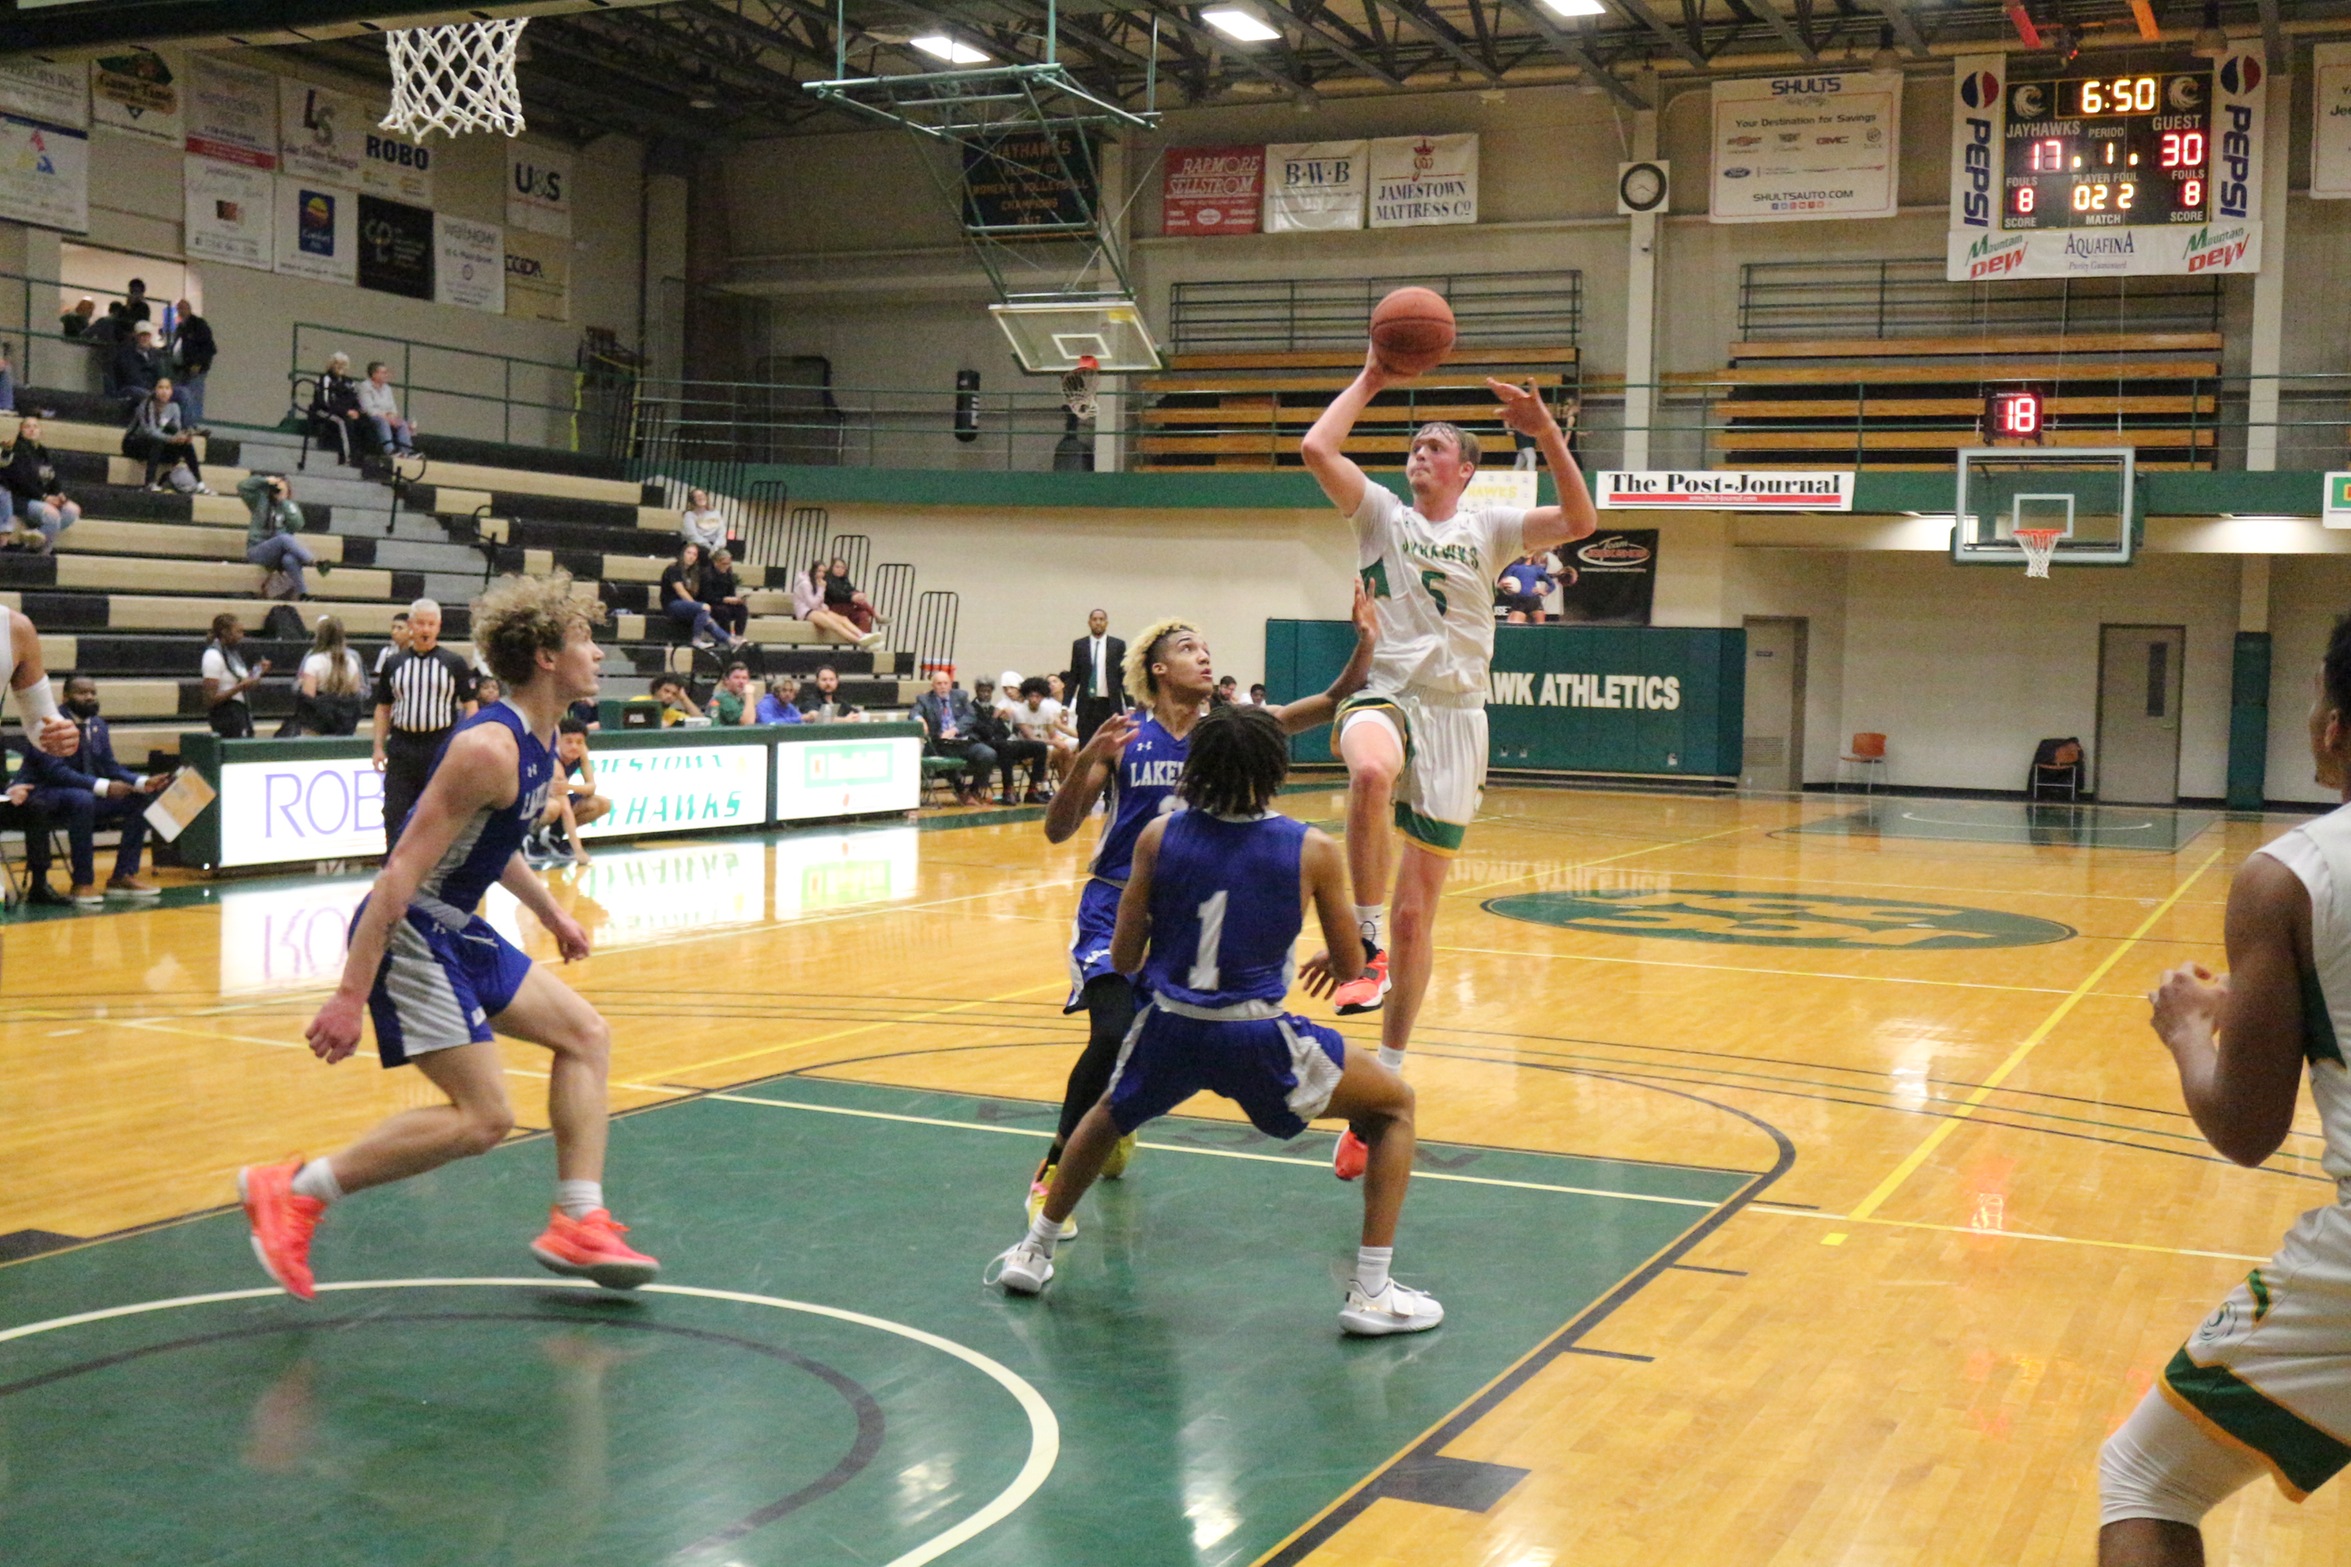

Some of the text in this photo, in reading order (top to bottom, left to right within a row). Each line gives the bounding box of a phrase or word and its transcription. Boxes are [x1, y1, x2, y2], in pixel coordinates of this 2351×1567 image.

[1771, 77, 1841, 95] SHULTS
[2082, 78, 2156, 114] 6:50
[1736, 113, 1876, 129] Your Destination for Savings
[2006, 114, 2202, 138] JAYHAWKS PERIOD GUEST
[366, 133, 429, 171] ROBO
[2031, 140, 2062, 170] 17
[2161, 133, 2204, 167] 30
[2219, 104, 2252, 218] PEPSI
[1963, 117, 1992, 228] PEPSI
[2006, 169, 2205, 188] FOULS PLAYER FOUL FOULS
[1378, 181, 1467, 199] JAMESTOWN
[1752, 190, 1854, 203] SHULTSAUTO.COM
[2018, 187, 2034, 213] 8
[2073, 184, 2105, 211] 02
[2184, 181, 2201, 206] 8
[1376, 202, 1450, 221] MATTRESS
[2004, 211, 2204, 229] SCORE MATCH SCORE
[2006, 397, 2036, 432] 18
[1609, 472, 1841, 495] The Post-Journal
[1538, 672, 1681, 710] ATHLETICS
[1130, 760, 1185, 788] LAKE
[1187, 890, 1229, 991] 1
